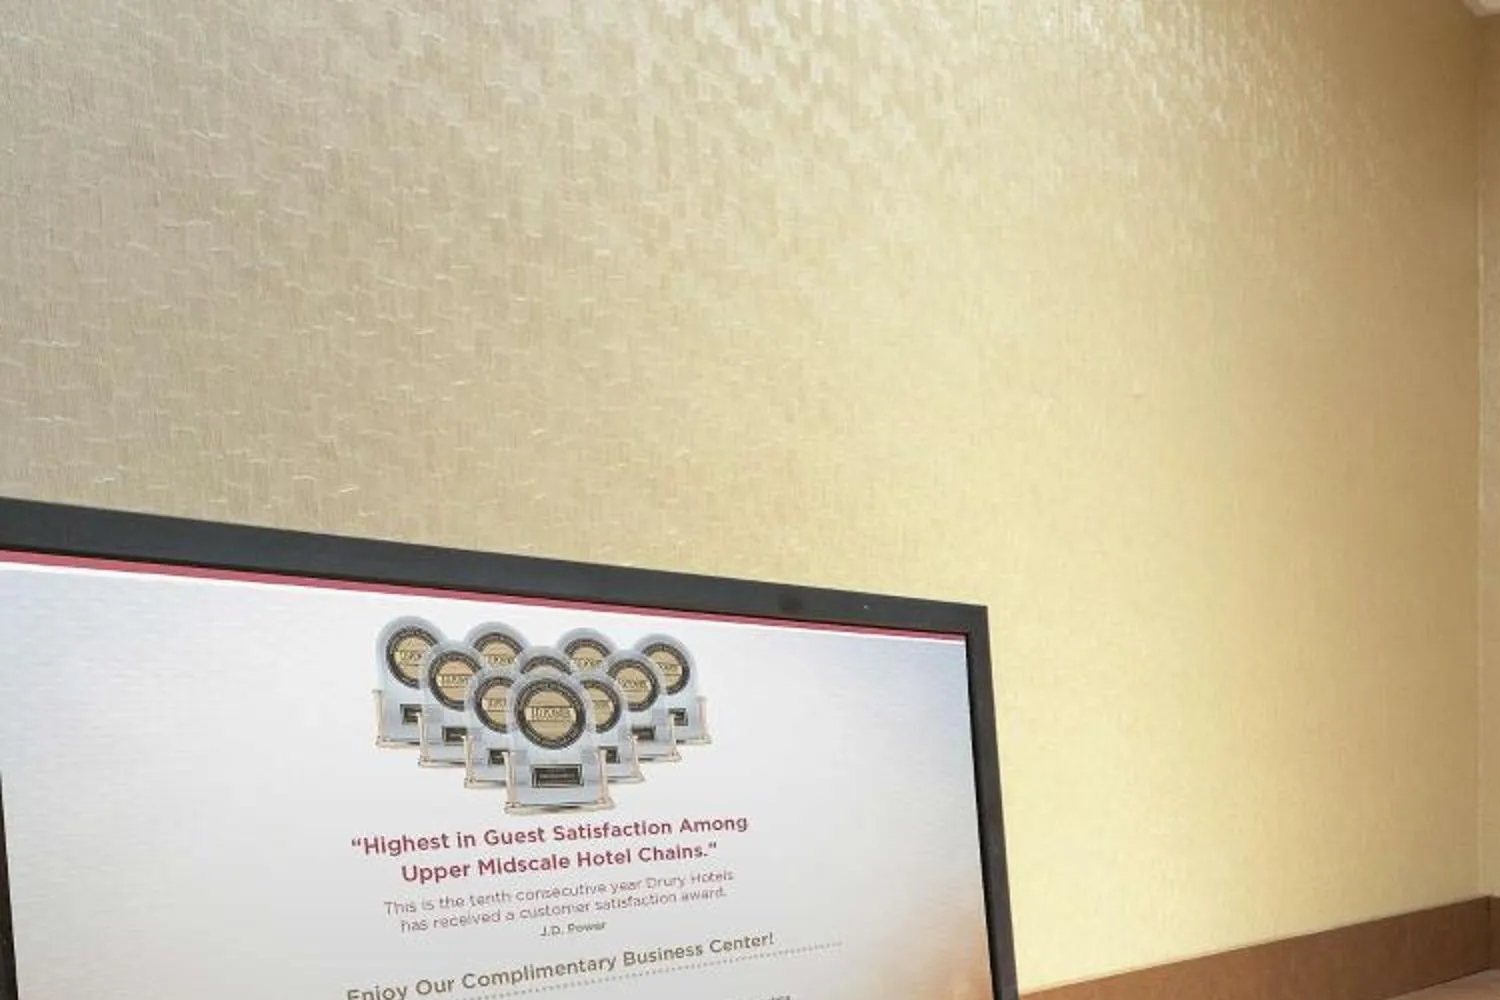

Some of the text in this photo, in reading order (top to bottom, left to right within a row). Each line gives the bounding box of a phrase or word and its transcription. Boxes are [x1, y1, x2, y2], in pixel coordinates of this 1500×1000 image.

[457, 831, 476, 849] in
[484, 826, 546, 846] Guest
[553, 819, 673, 842] Satisfaction
[679, 816, 749, 834] Among
[401, 862, 471, 885] Upper
[478, 853, 571, 876] Midscale
[577, 848, 632, 868] Hotel
[384, 870, 734, 916] This is the tenth consecutive year Drury Hotels
[401, 888, 727, 933] has received a customer satisfaction award.
[540, 921, 606, 937] J.D. Power
[415, 977, 455, 996] Our
[462, 955, 617, 989] Complimentary
[623, 944, 703, 967] Business
[709, 932, 774, 953] Center!
